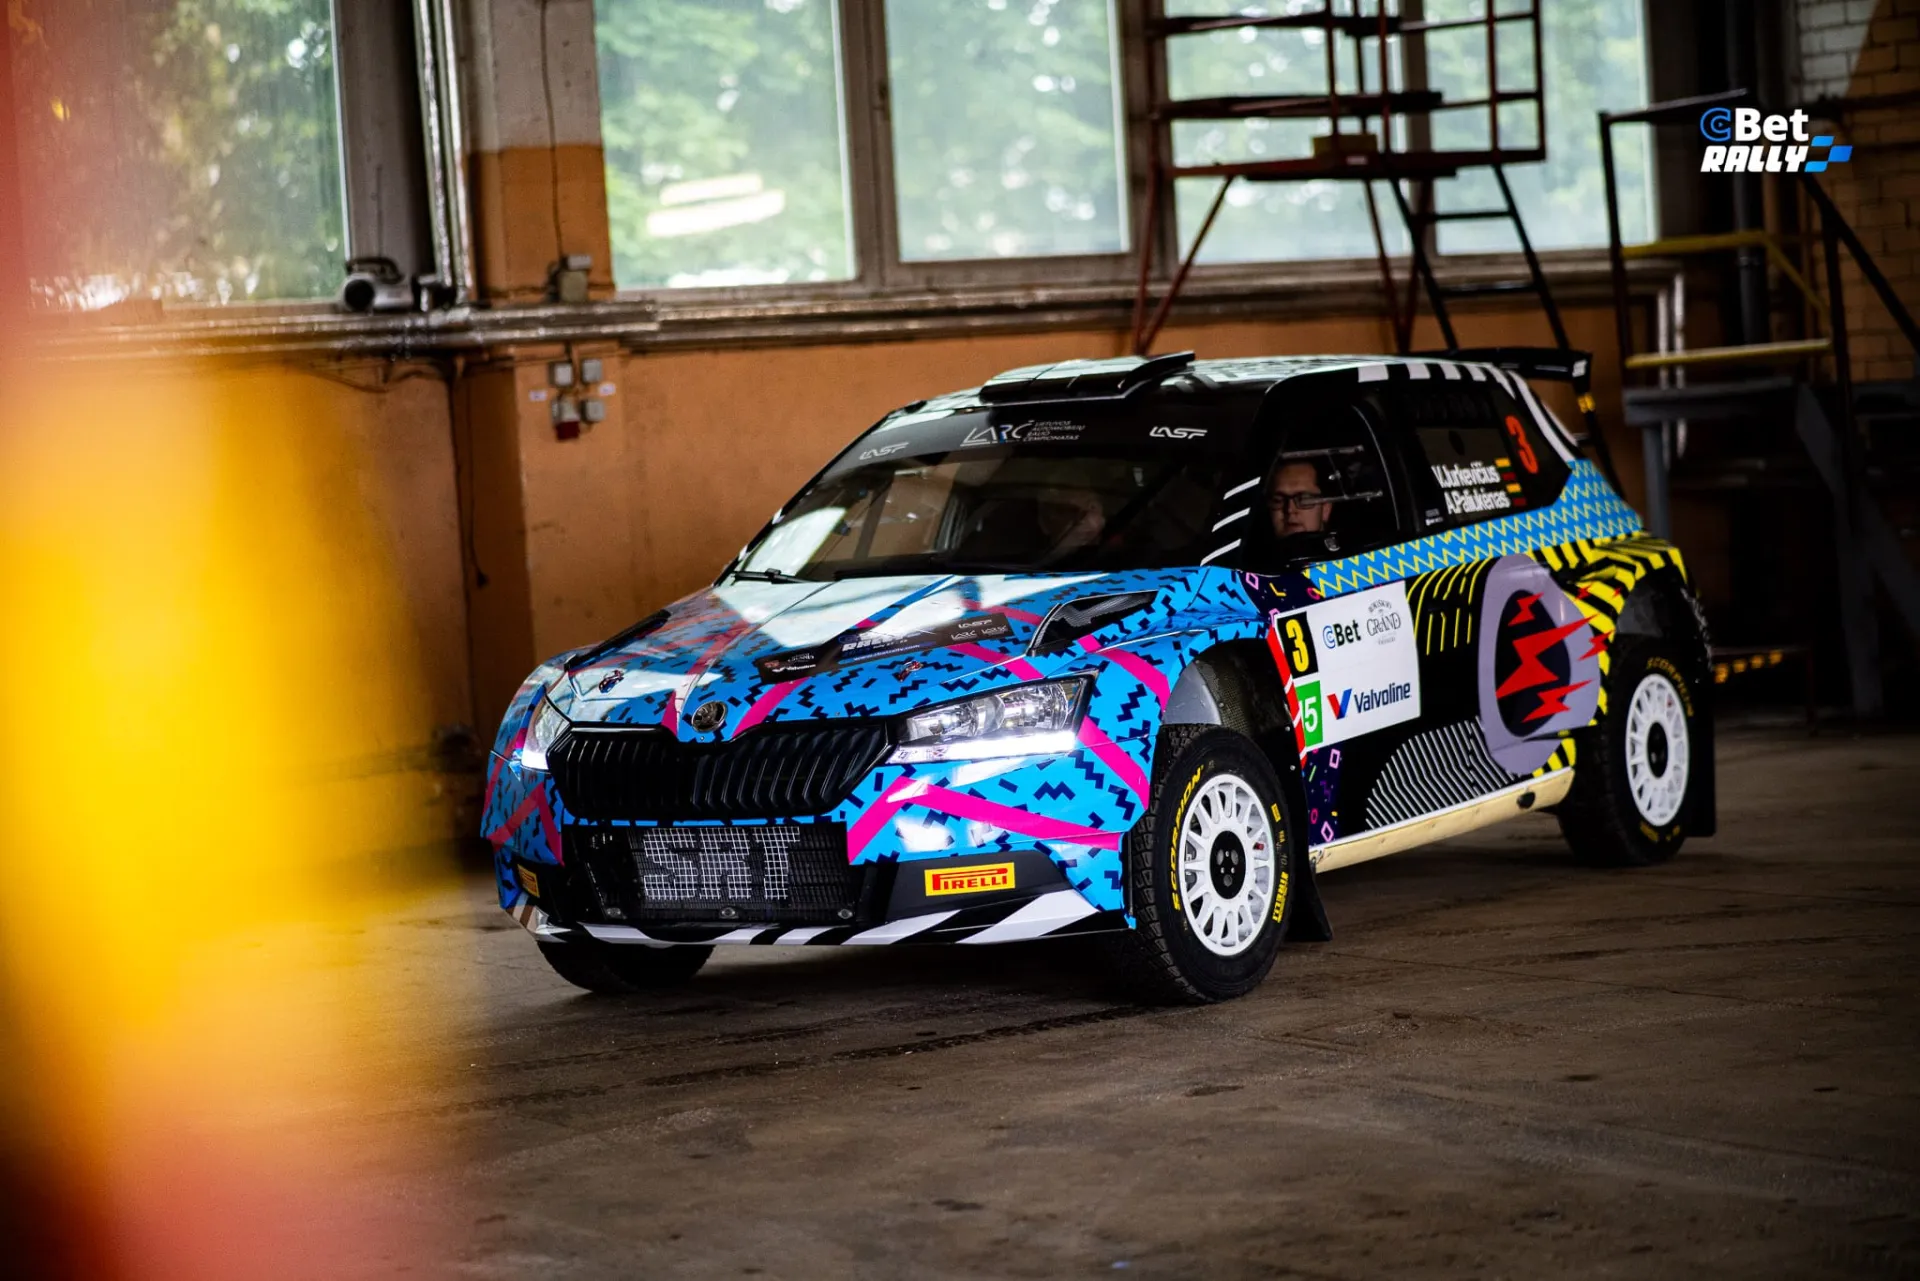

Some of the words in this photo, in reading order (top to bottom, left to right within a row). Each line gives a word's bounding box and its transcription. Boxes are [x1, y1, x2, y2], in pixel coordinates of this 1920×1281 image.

[1150, 426, 1208, 439] LASF
[1505, 415, 1539, 474] 3
[859, 441, 909, 460] LASF
[1366, 612, 1402, 637] GRAND
[1285, 619, 1309, 673] 3
[1354, 682, 1411, 713] Valvoline
[1170, 764, 1205, 912] SCORPION
[643, 826, 801, 900] SRT
[932, 867, 1008, 891] PIRELLI
